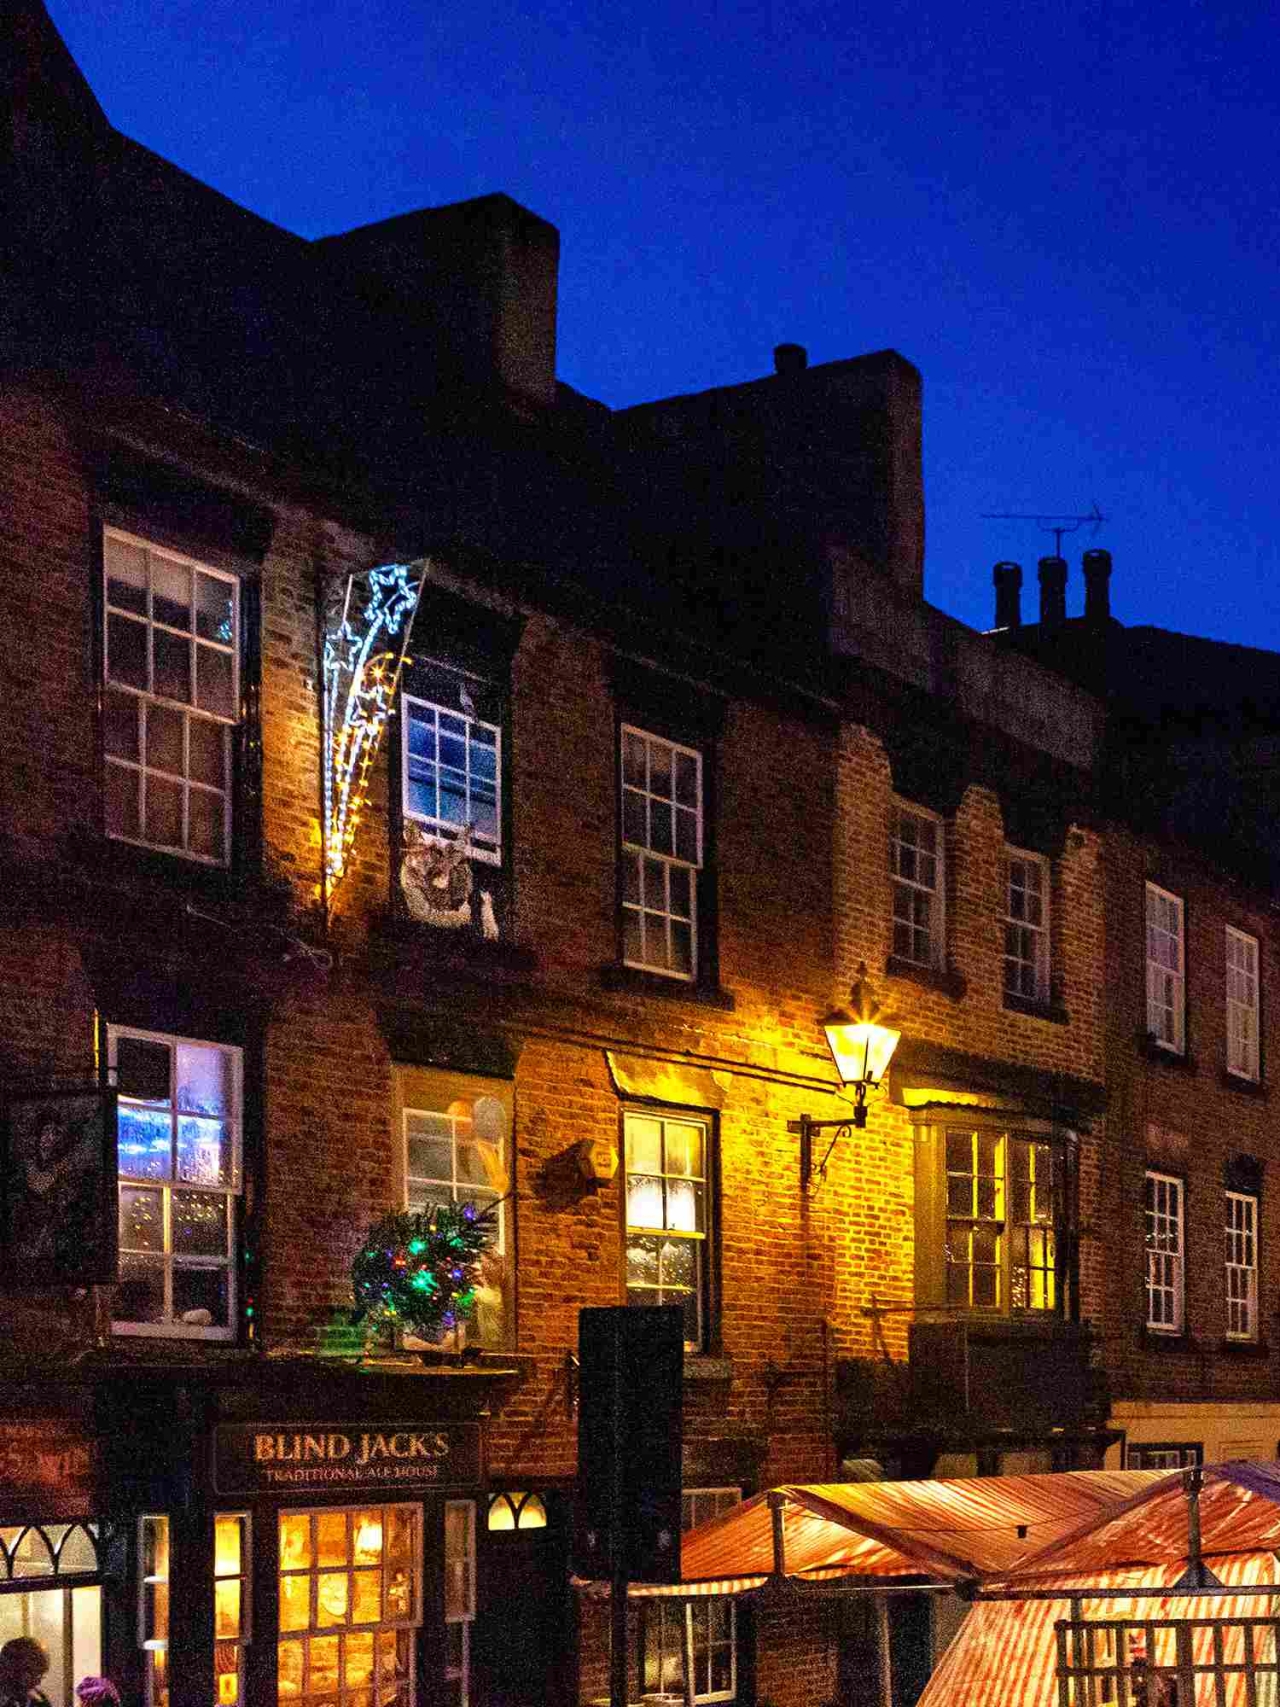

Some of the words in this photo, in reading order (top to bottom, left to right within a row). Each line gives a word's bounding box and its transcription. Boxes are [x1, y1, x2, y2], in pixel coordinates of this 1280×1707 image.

[255, 1433, 349, 1462] BLIND
[267, 1466, 361, 1482] TRADITIONAL
[367, 1465, 391, 1478] ALE
[394, 1464, 438, 1478] HOUSE
